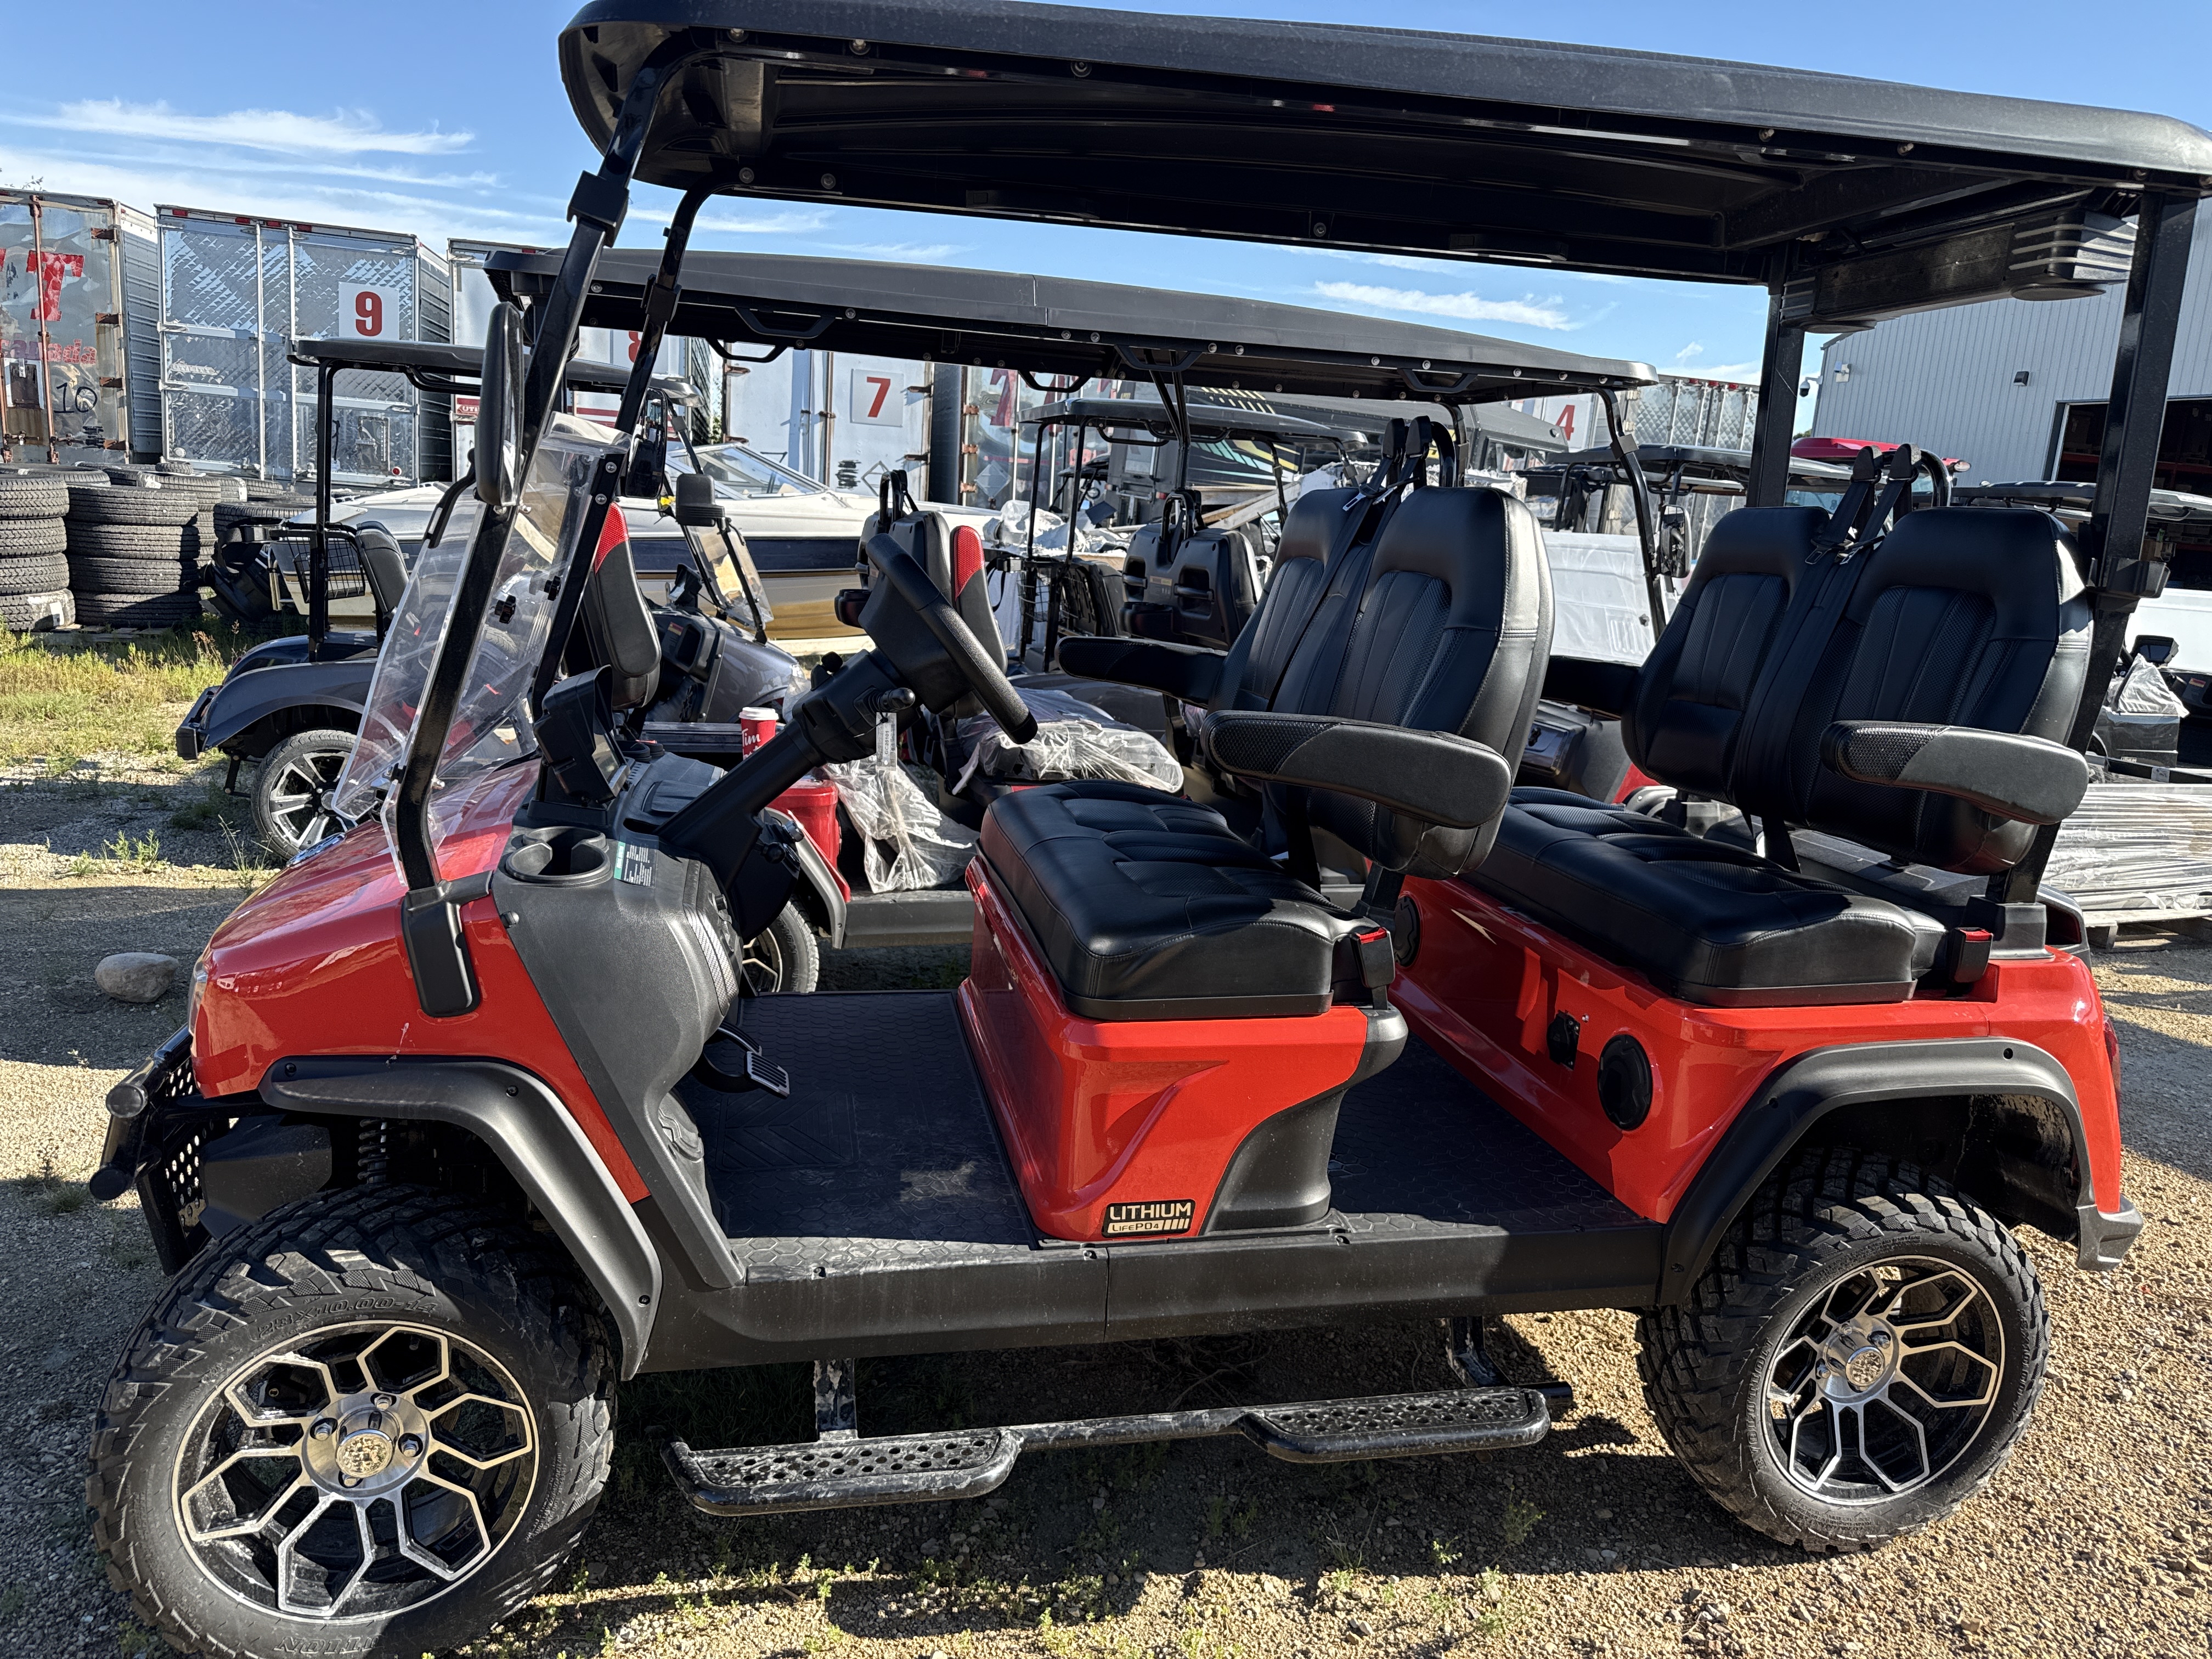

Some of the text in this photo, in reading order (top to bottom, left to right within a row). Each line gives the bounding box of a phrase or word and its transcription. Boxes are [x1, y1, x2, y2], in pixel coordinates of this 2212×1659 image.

[356, 291, 382, 336] 9
[53, 382, 98, 413] 10
[867, 376, 891, 417] 7
[1556, 404, 1575, 441] 4
[742, 728, 761, 747] Tim
[1110, 1203, 1191, 1221] LITHIUM
